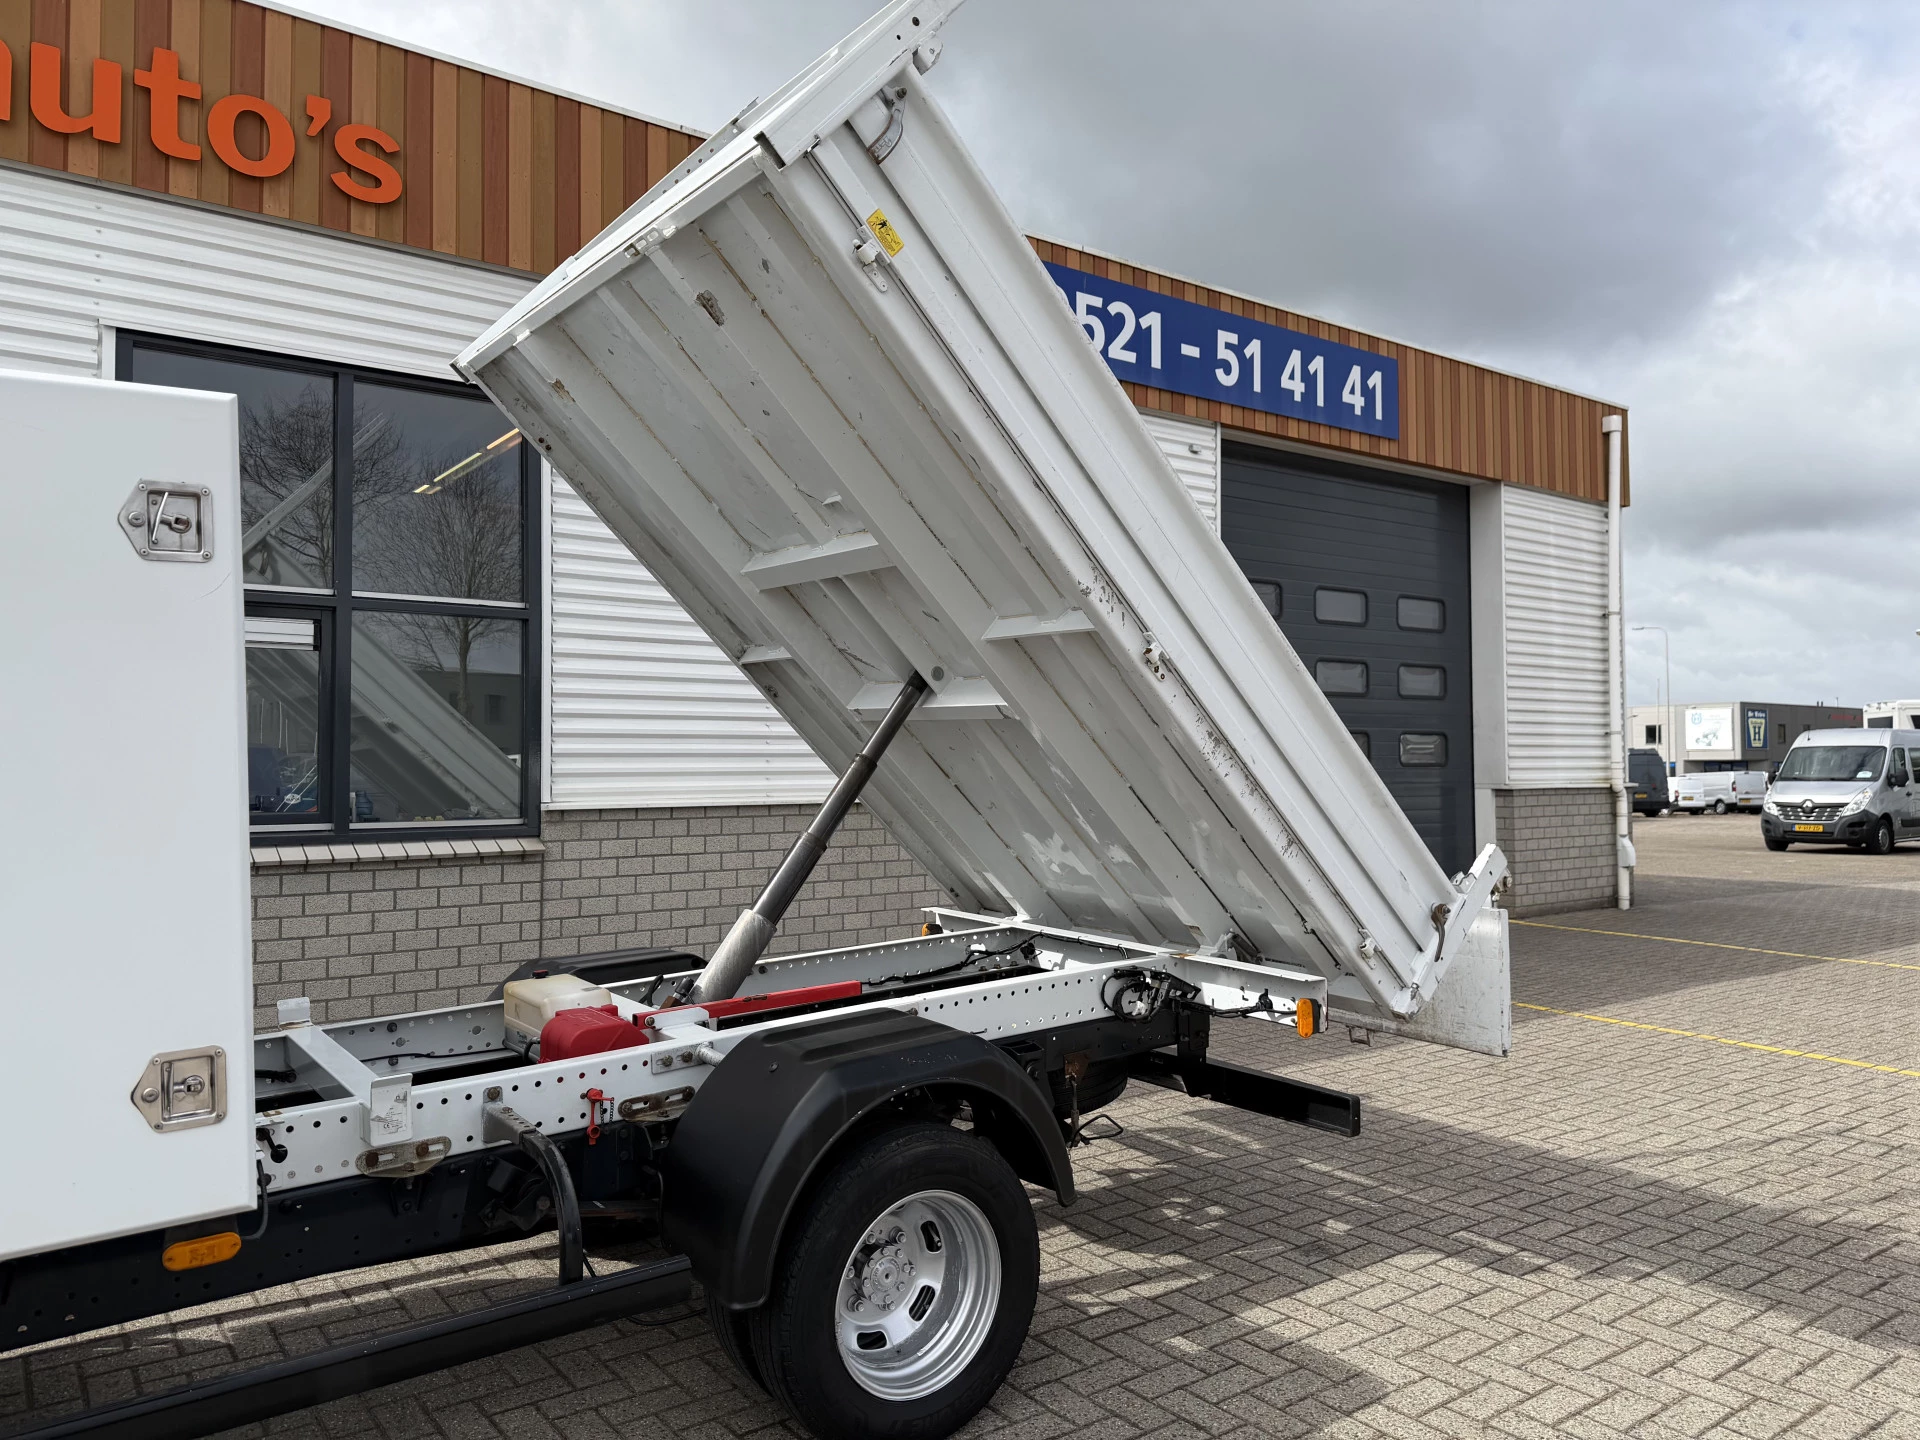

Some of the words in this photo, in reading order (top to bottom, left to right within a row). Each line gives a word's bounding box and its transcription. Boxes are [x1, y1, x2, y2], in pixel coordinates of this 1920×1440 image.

[0, 40, 402, 204] uto's
[1056, 285, 1162, 369] 521
[1215, 329, 1261, 393] 51
[1281, 349, 1324, 407] 41
[1342, 365, 1382, 420] 41
